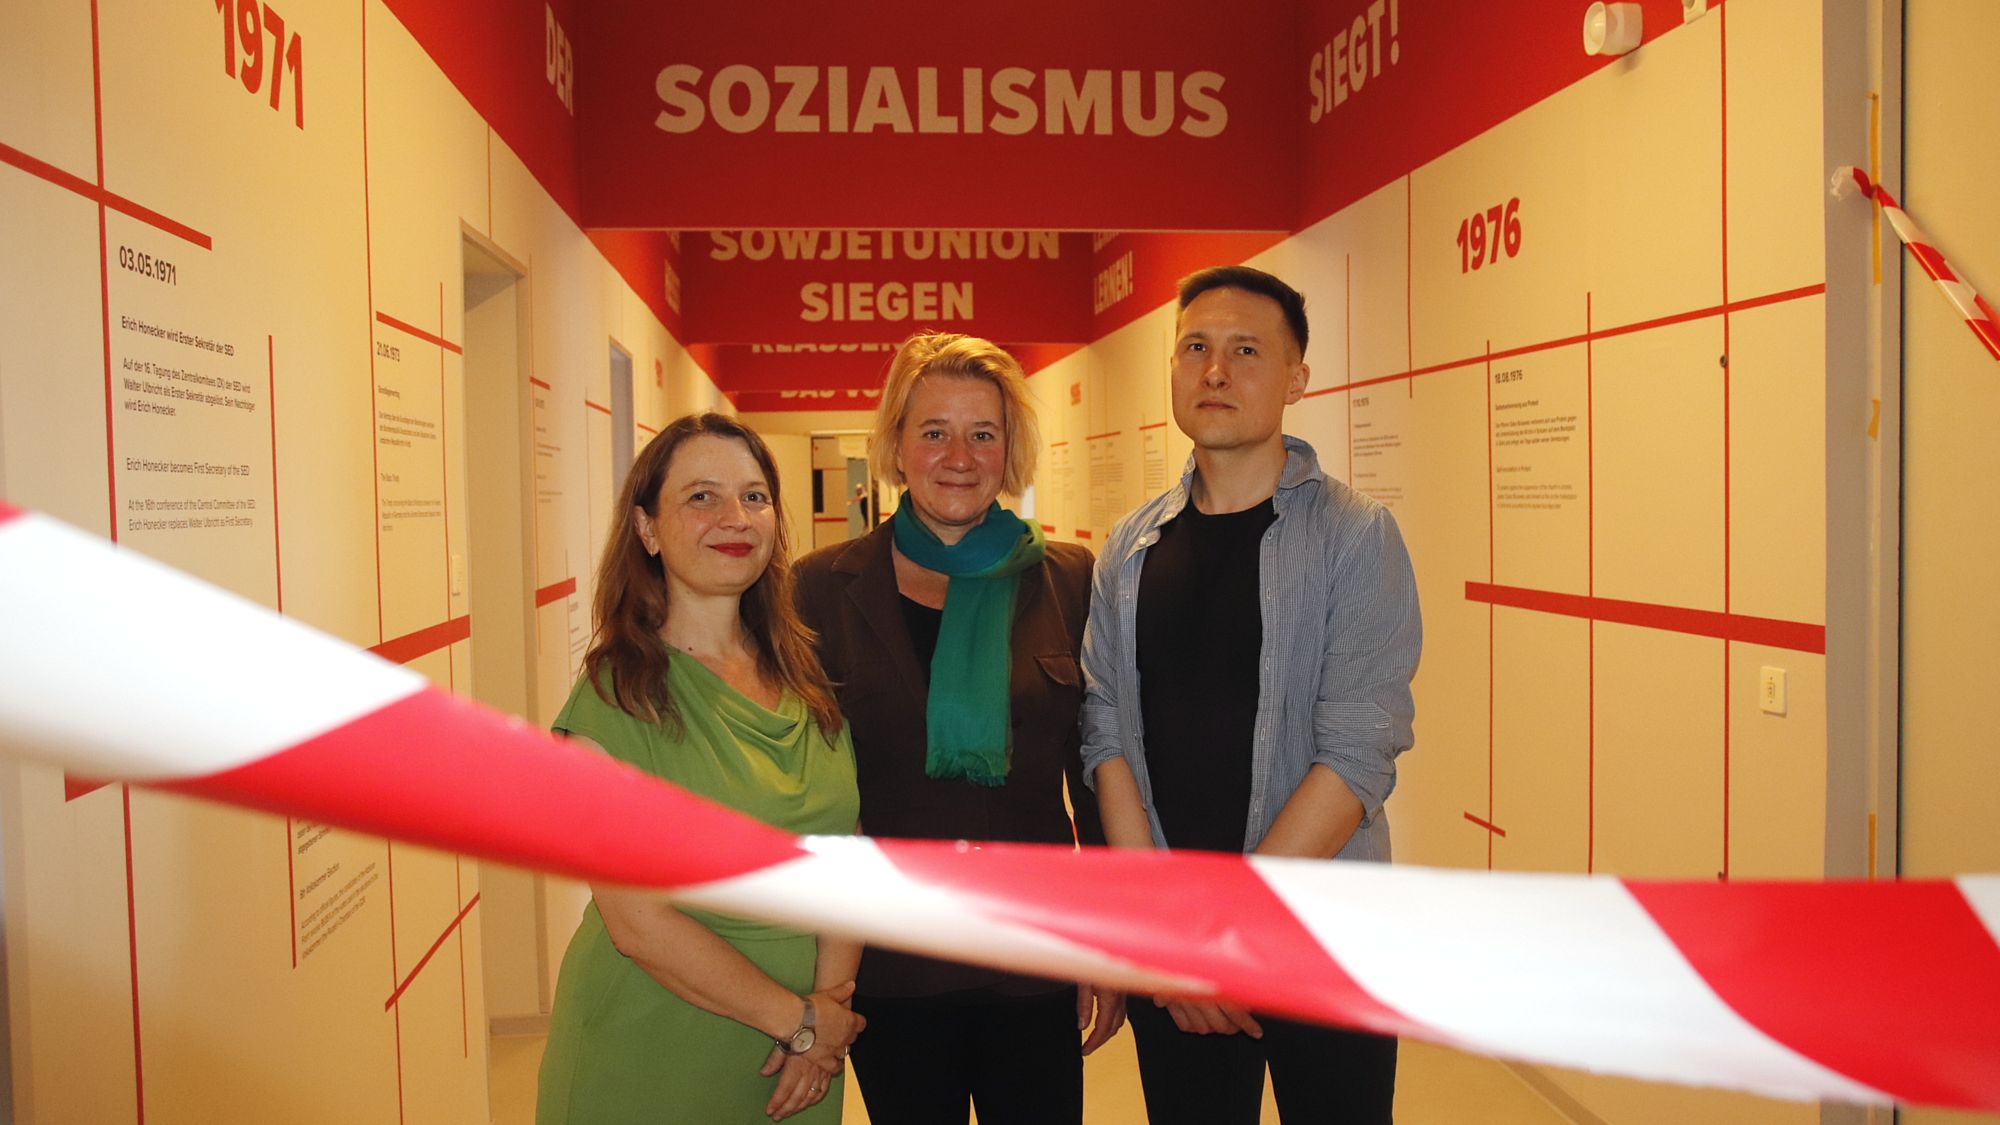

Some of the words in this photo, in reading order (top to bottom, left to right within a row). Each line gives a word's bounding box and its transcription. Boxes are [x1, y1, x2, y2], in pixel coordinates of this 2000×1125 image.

[215, 0, 304, 131] 1971
[546, 1, 574, 117] DER
[1309, 0, 1400, 124] SIEGT!
[653, 63, 1229, 139] SOZIALISMUS
[710, 230, 1060, 261] SOWJETUNION
[1456, 196, 1522, 275] 1976
[119, 245, 177, 287] 03.05.1971
[800, 282, 974, 322] SIEGEN
[121, 315, 137, 331] Erich
[138, 320, 166, 338] Honecker
[167, 329, 179, 342] wird
[179, 332, 194, 346] Erster
[195, 336, 215, 351] Sekretär
[224, 344, 235, 357] SED
[127, 457, 141, 471] Erich
[142, 459, 169, 473] Honecker
[170, 460, 193, 474] becomes
[194, 461, 205, 474] First
[205, 462, 227, 478] Secretary
[227, 464, 232, 476] of
[232, 464, 240, 476] the
[240, 464, 249, 476] SED
